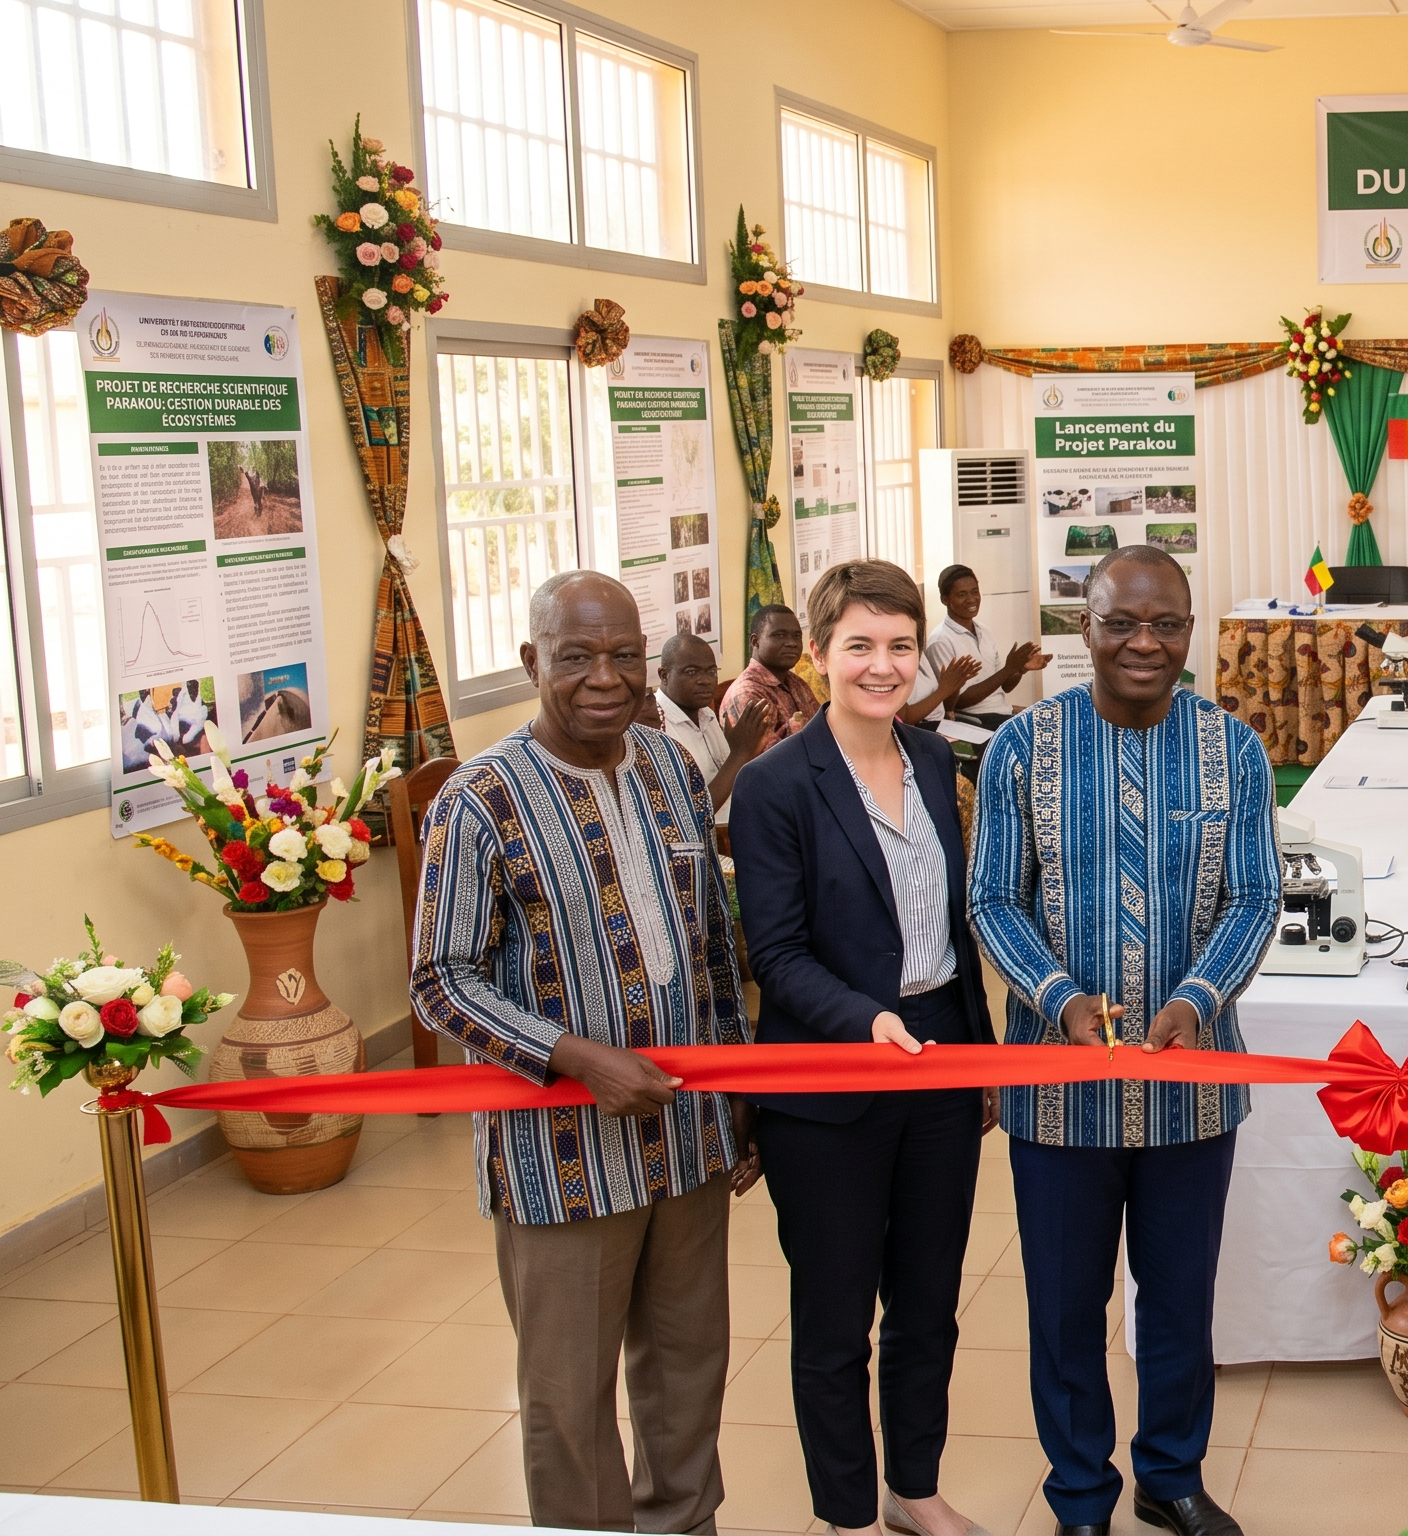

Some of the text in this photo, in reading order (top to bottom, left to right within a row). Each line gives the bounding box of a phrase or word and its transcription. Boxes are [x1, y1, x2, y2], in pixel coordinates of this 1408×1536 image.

[1356, 167, 1406, 195] DU
[96, 380, 288, 397] PROJET DE RECHERCHE SCIENTIFIQUE
[106, 397, 166, 410] PARAKOU:
[214, 399, 262, 411] DURABLE
[262, 400, 282, 411] DES
[1055, 419, 1175, 434] Lancement du
[1055, 436, 1177, 455] Projet Parakou
